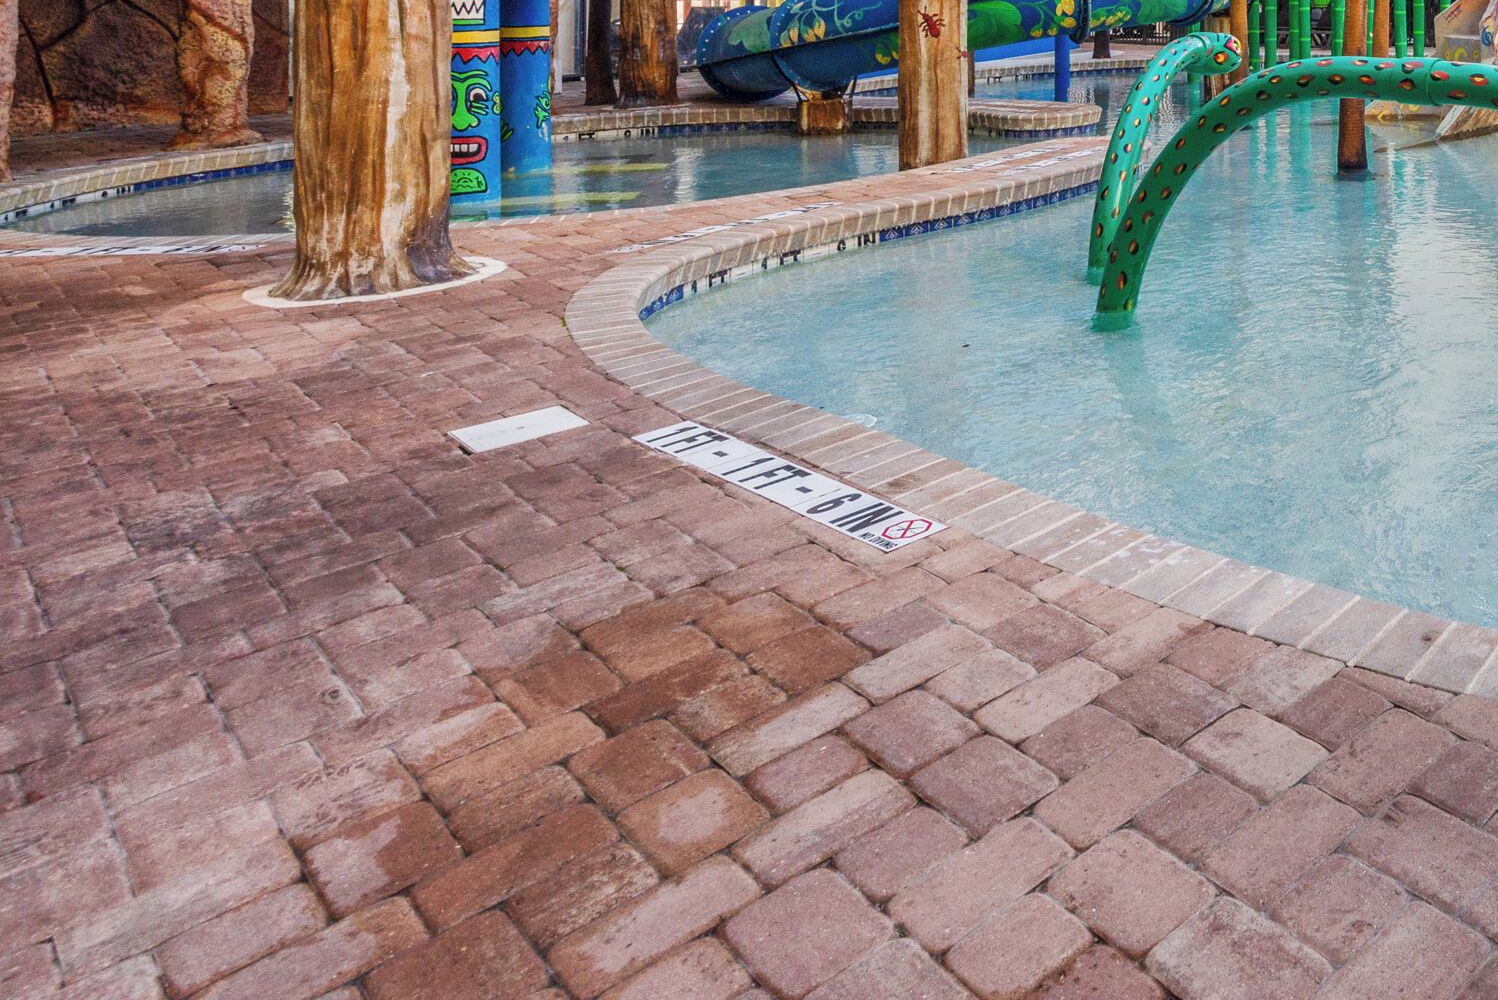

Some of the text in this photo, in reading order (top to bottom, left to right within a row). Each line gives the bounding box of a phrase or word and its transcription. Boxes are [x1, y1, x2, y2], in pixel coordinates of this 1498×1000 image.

[780, 250, 801, 265] FT
[858, 232, 876, 247] IN
[646, 426, 699, 443] 1
[660, 431, 730, 454] FT
[721, 457, 775, 476] 1
[738, 464, 812, 490] FT
[806, 493, 862, 514] 6
[828, 502, 904, 533] IN
